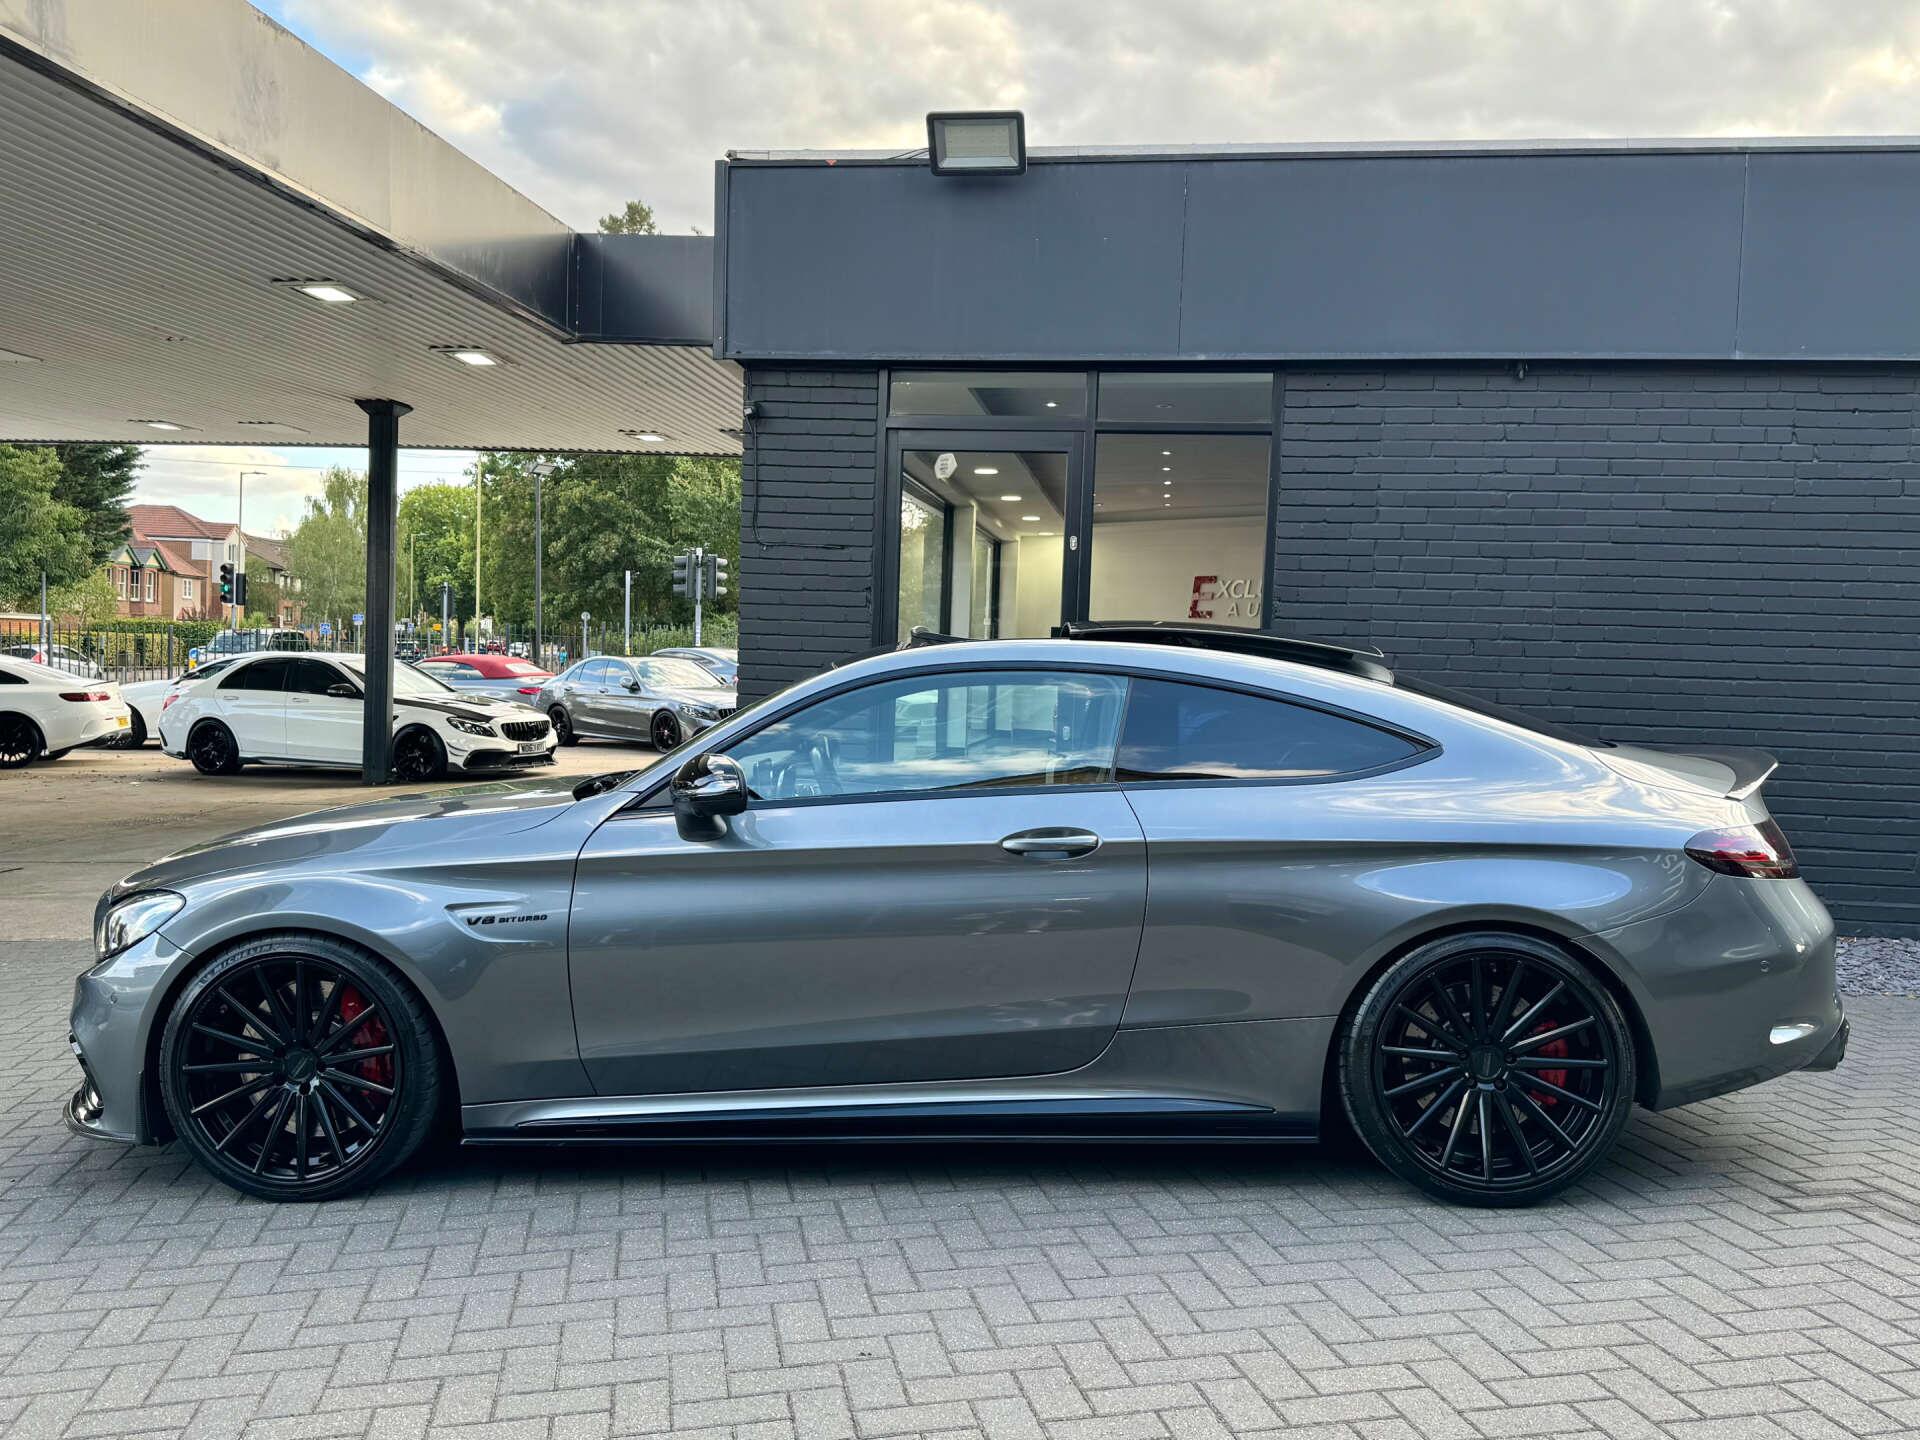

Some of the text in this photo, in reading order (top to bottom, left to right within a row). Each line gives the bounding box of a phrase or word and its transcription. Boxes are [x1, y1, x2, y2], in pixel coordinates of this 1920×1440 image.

[1188, 575, 1262, 619] EXCL
[466, 914, 548, 926] V8 BITURBO
